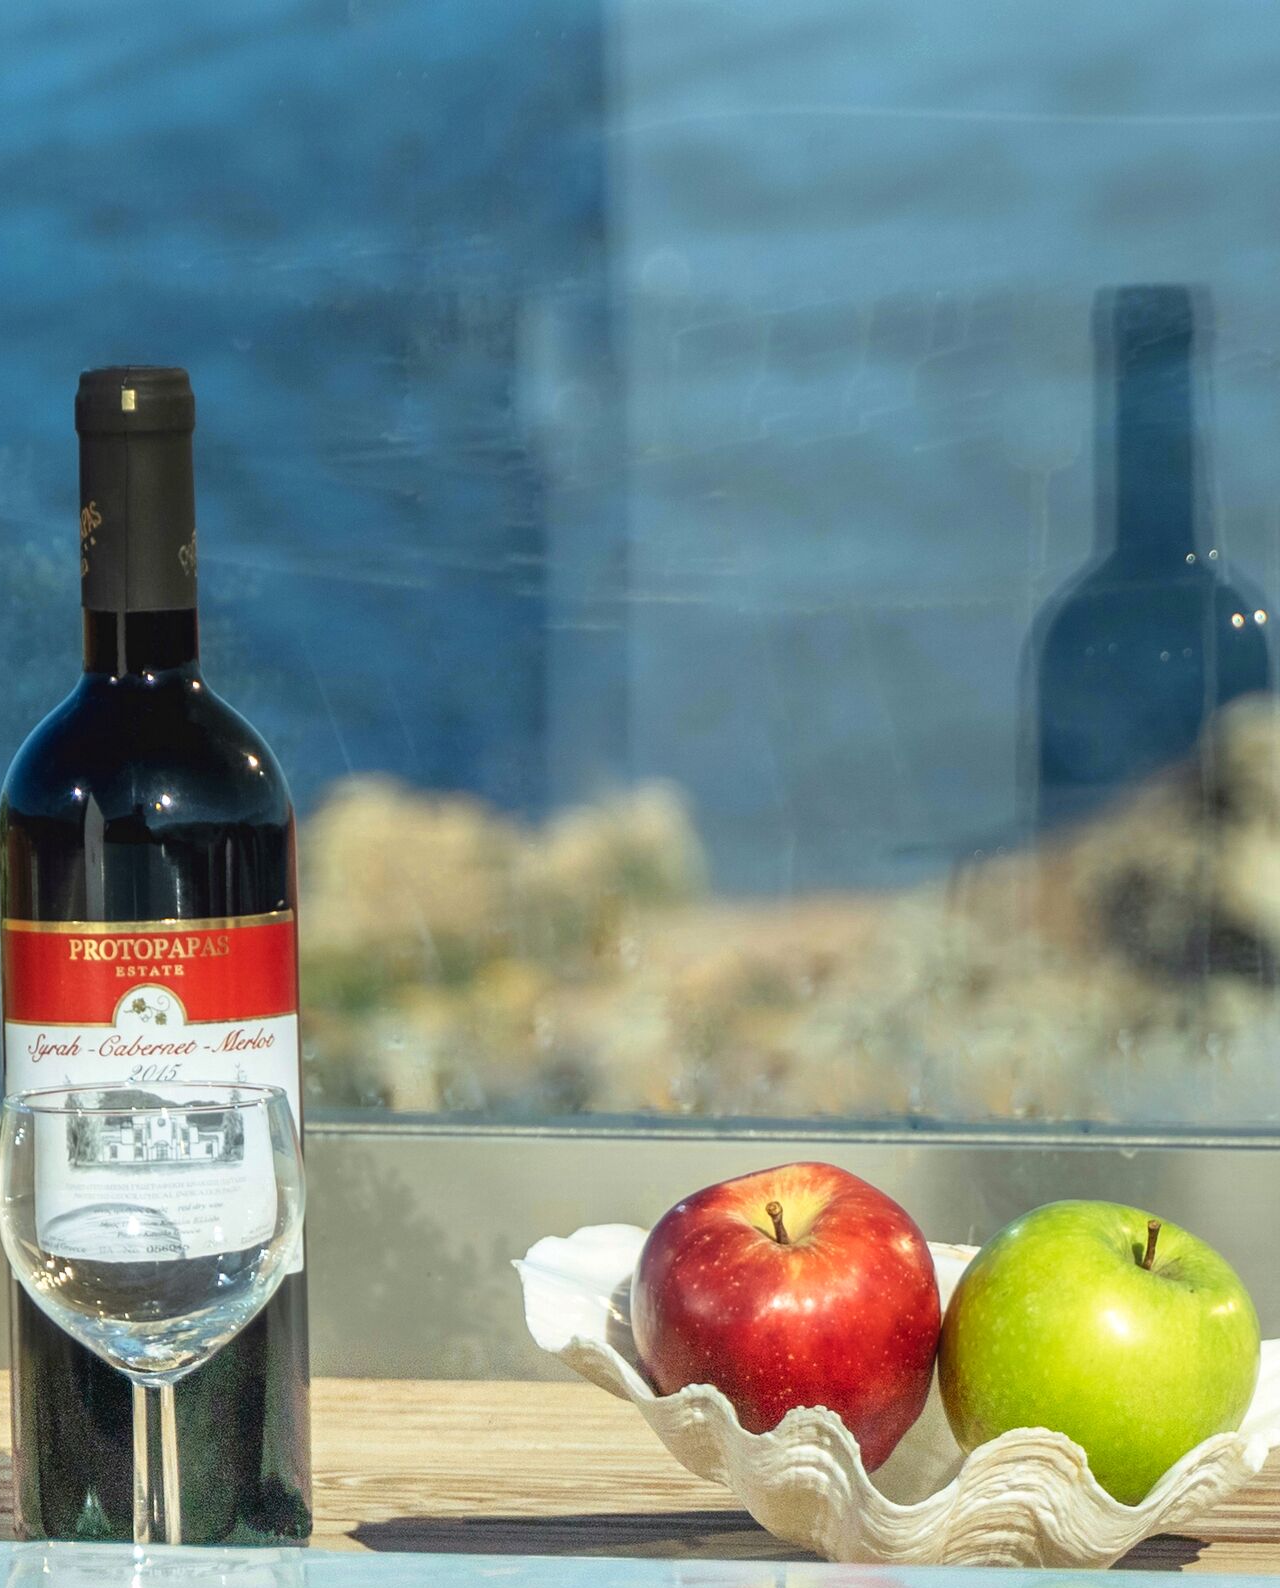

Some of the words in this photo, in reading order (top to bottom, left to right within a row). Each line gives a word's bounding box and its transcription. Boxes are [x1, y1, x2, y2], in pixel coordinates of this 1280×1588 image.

[68, 935, 230, 961] PROTOPAPAS
[115, 964, 185, 977] ESTATE
[27, 1033, 82, 1063] Syrah
[98, 1035, 197, 1057] Cabernet
[211, 1027, 276, 1054] Merlot
[130, 1063, 183, 1083] 2015
